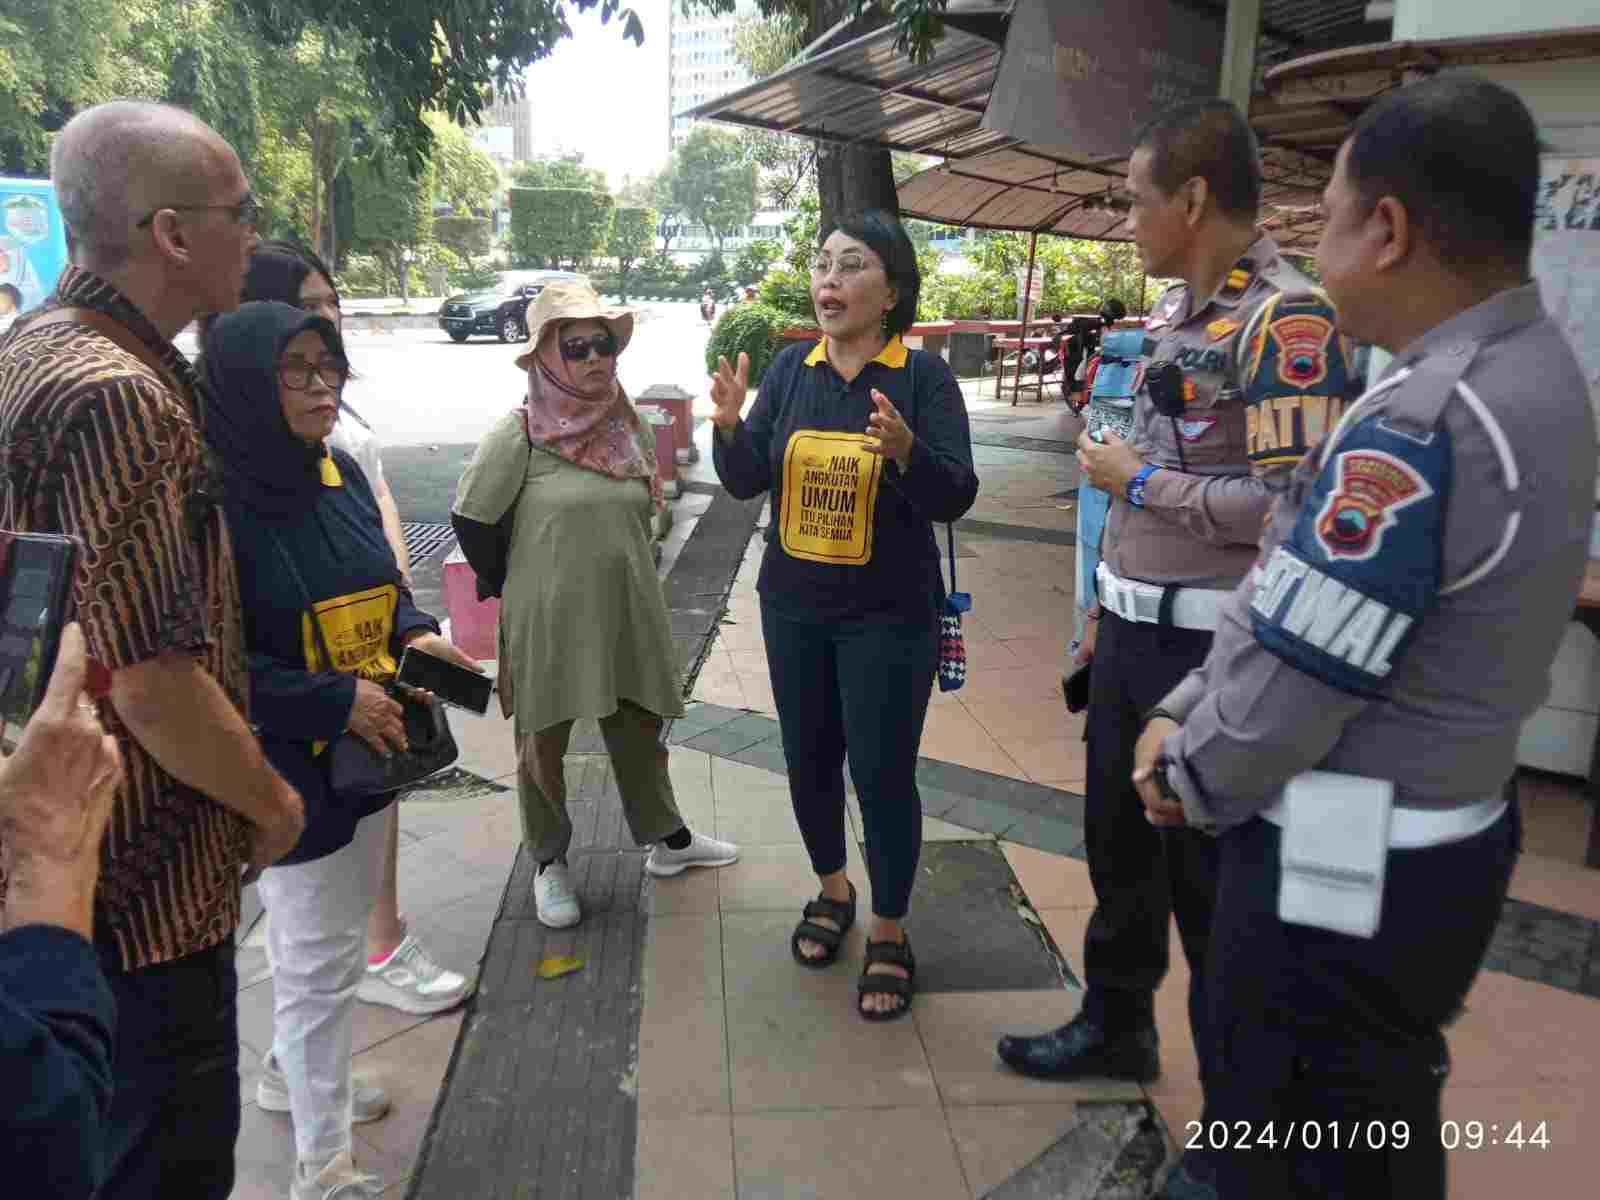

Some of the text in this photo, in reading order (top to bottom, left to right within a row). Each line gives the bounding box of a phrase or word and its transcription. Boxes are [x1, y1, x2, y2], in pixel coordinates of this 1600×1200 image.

[828, 455, 861, 474] NAIK
[802, 470, 860, 489] ANGKUTAN
[801, 485, 857, 513] UMUM
